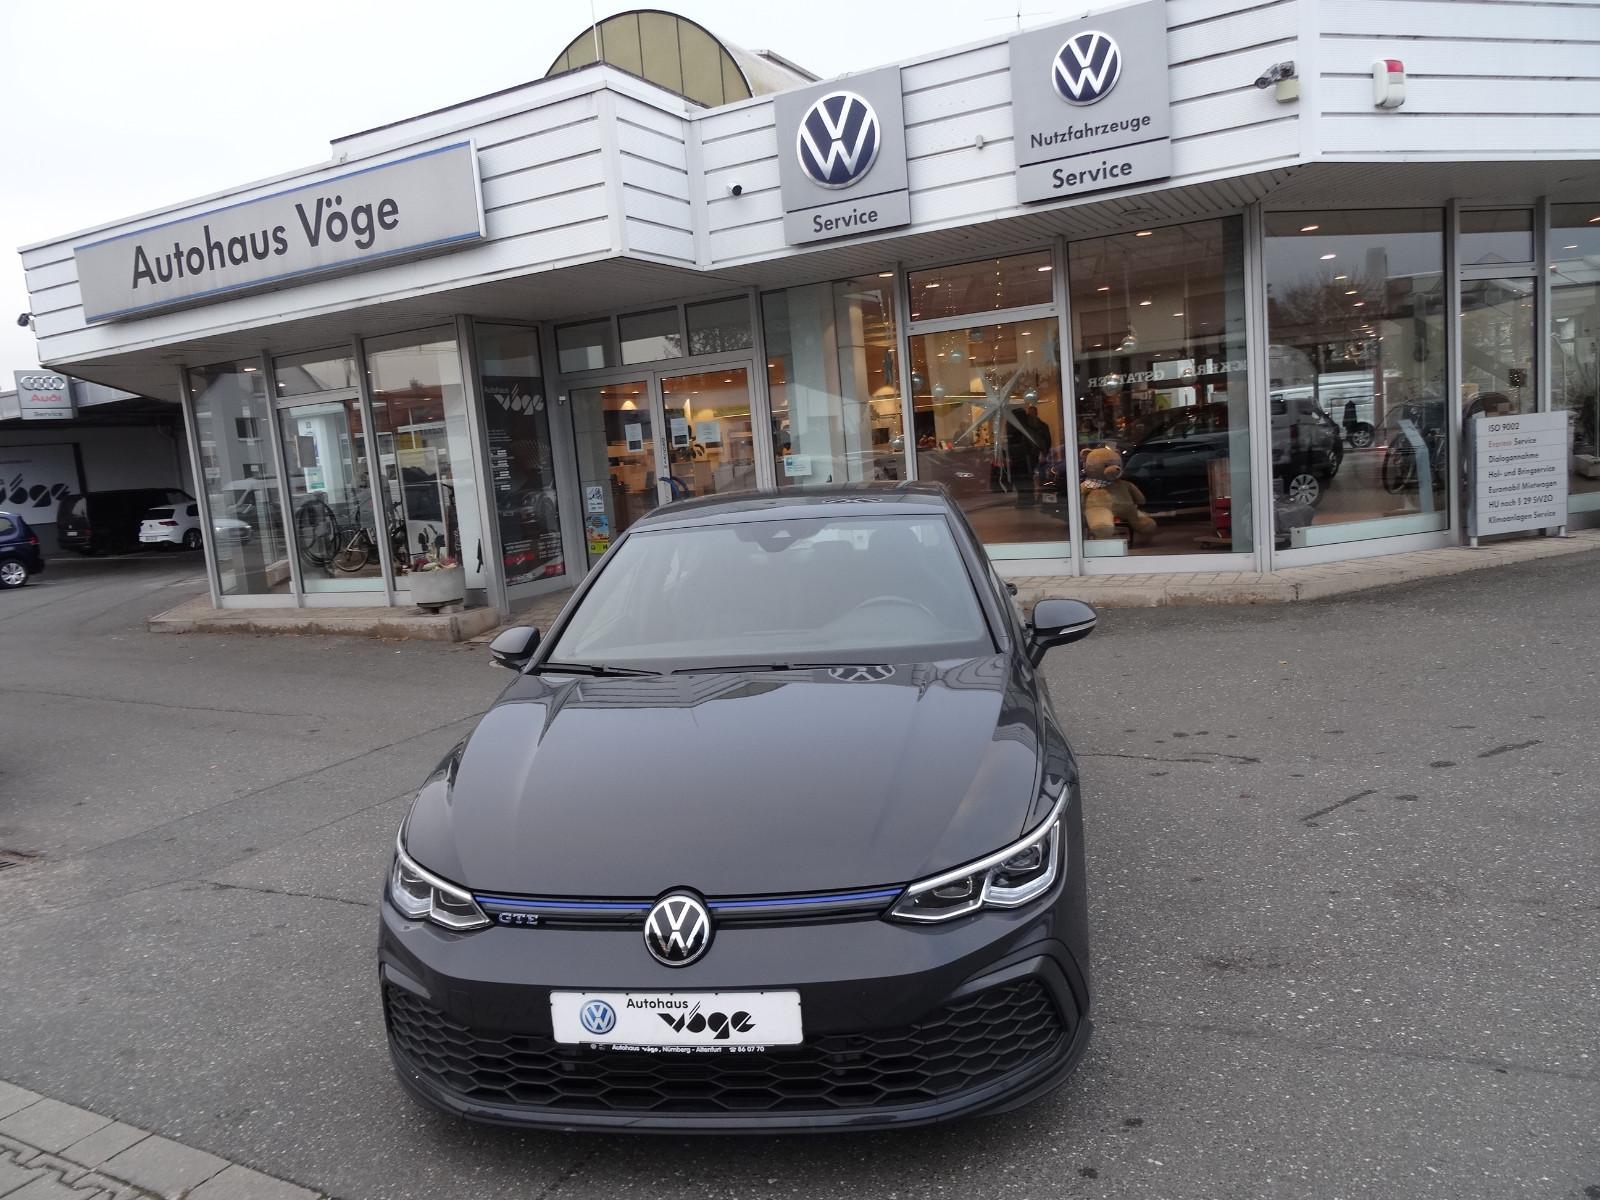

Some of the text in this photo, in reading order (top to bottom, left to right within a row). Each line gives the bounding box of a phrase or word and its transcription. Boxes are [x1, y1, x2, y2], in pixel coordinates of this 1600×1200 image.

[1031, 113, 1152, 149] Nutzfahrzeuge
[1052, 161, 1133, 189] Service
[813, 208, 879, 234] Service
[132, 195, 400, 290] Autohaus Vöge
[31, 394, 62, 402] Audi
[1488, 422, 1520, 433] ISO 9002
[1513, 437, 1537, 446] Service
[1488, 452, 1538, 463] Dialogannahme
[1503, 468, 1517, 477] und
[1517, 465, 1556, 476] Bringservice
[1521, 481, 1557, 490] Mietwagen
[1488, 499, 1499, 509] HU
[1500, 498, 1516, 508] nach
[1523, 496, 1532, 505] 29
[1488, 509, 1557, 523] Klimaanlagen Service
[498, 912, 539, 926] GTE
[626, 998, 689, 1009] Autohaus
[611, 1044, 640, 1052] Autohaus
[662, 1045, 691, 1054] Nürnberg
[695, 1045, 722, 1054] Altenfurt
[737, 1045, 746, 1053] 86
[747, 1045, 755, 1053] 07
[756, 1045, 765, 1053] 70
